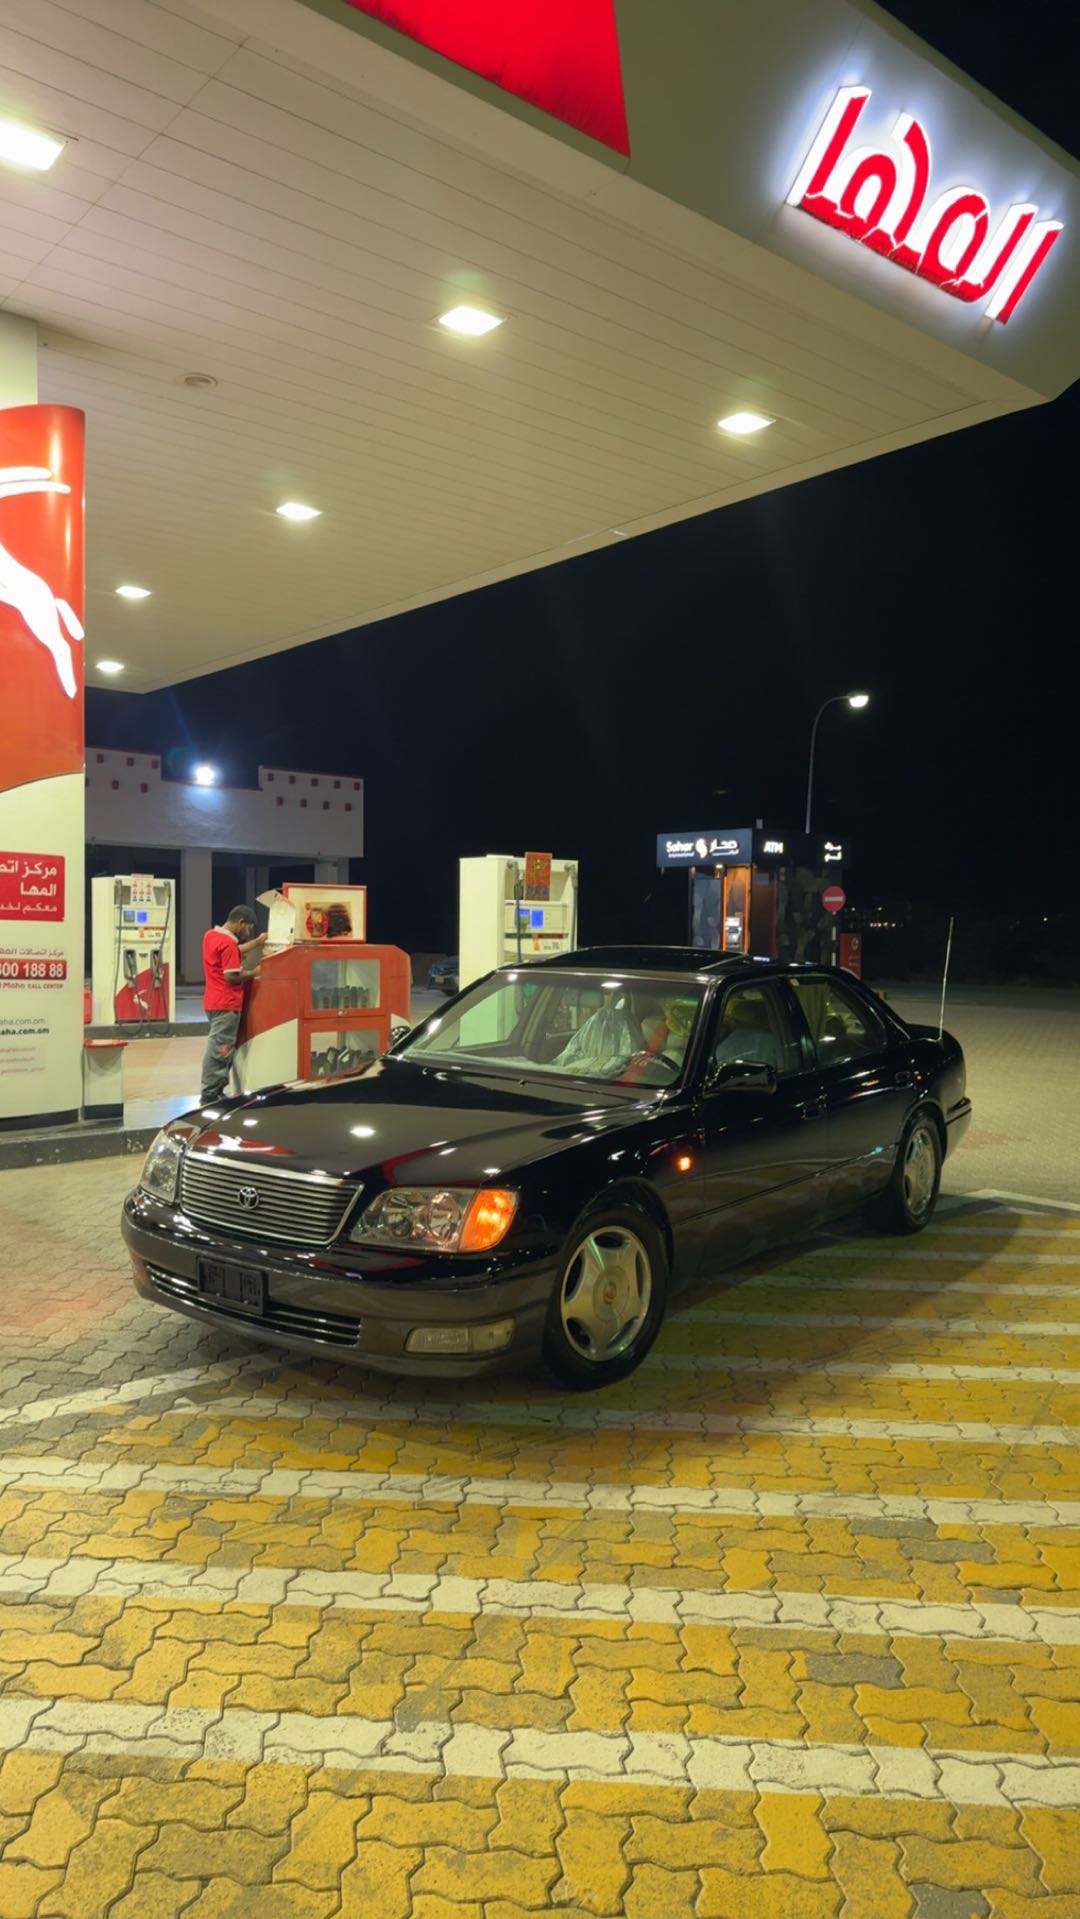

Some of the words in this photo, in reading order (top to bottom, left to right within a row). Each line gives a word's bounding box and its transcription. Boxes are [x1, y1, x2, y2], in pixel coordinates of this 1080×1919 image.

[785, 85, 1064, 325] المها
[763, 841, 784, 854] ATM
[21, 861, 57, 880] مركز
[20, 882, 57, 896] المها
[22, 902, 57, 915] معكم
[22, 962, 46, 978] 188
[49, 963, 64, 978] 88
